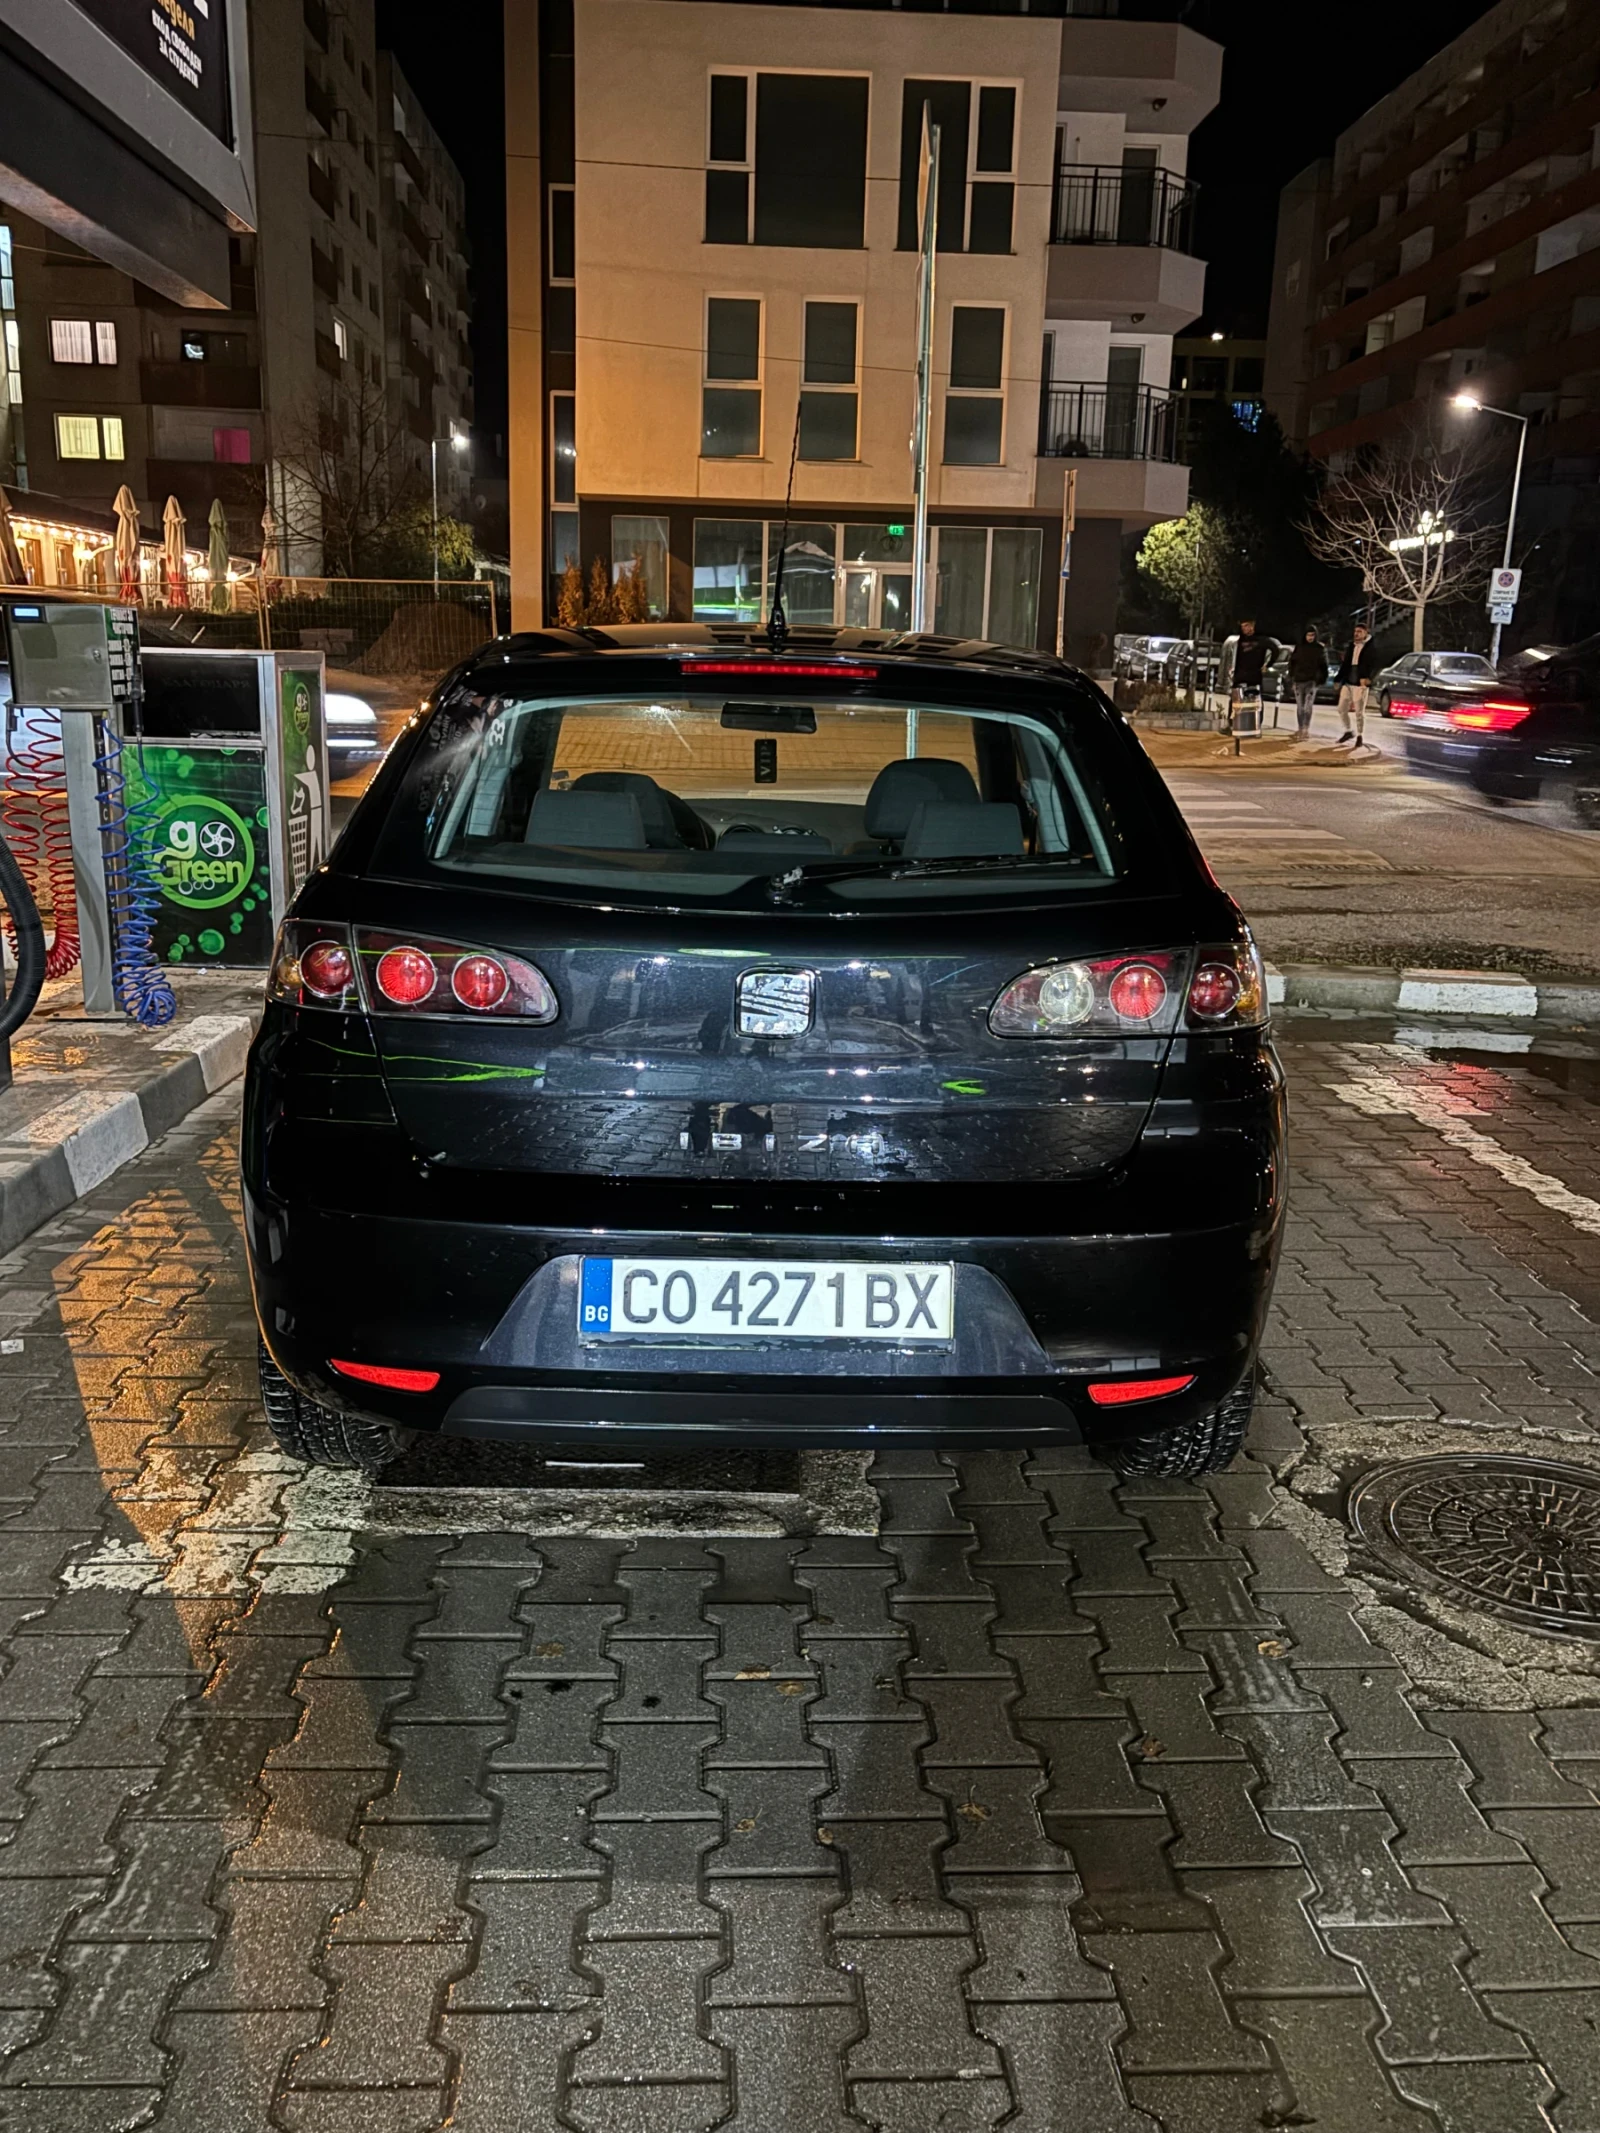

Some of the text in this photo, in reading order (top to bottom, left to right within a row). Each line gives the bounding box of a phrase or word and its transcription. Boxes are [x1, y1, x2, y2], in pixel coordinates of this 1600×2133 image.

[157, 0, 195, 41] еделя
[171, 30, 202, 74] СВОБОДЕН
[585, 1304, 609, 1323] BG
[622, 1269, 939, 1330] CO 4271 BX
